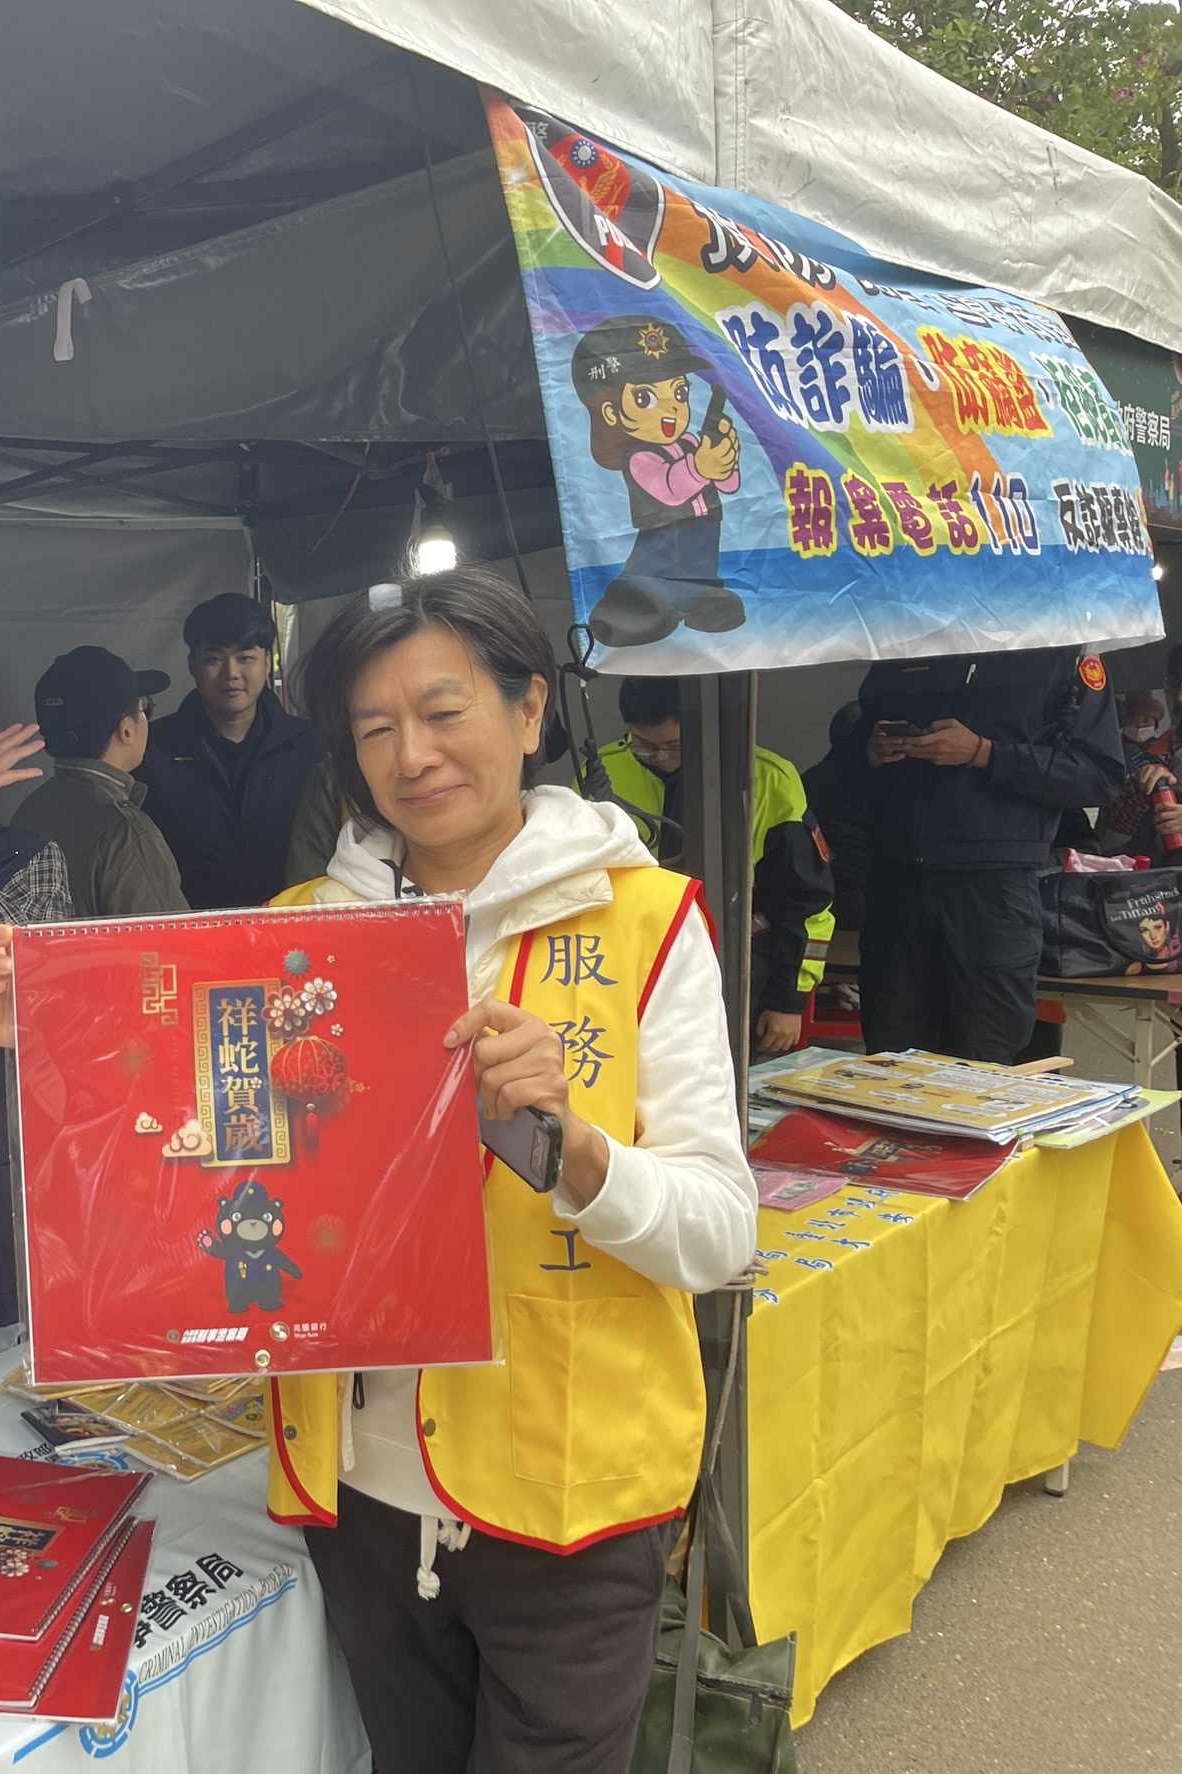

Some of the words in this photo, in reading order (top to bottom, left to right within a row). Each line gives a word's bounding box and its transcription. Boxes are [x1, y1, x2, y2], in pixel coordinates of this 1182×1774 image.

[587, 356, 622, 381] 刑警
[1114, 400, 1171, 450] 府警察局
[217, 997, 264, 1153] 祥蛇賀歲
[539, 933, 619, 1271] 服務工
[138, 1636, 187, 1684] CRIMINAL
[190, 1585, 258, 1647] INVESTIGATION
[258, 1562, 294, 1597] BUREAU
